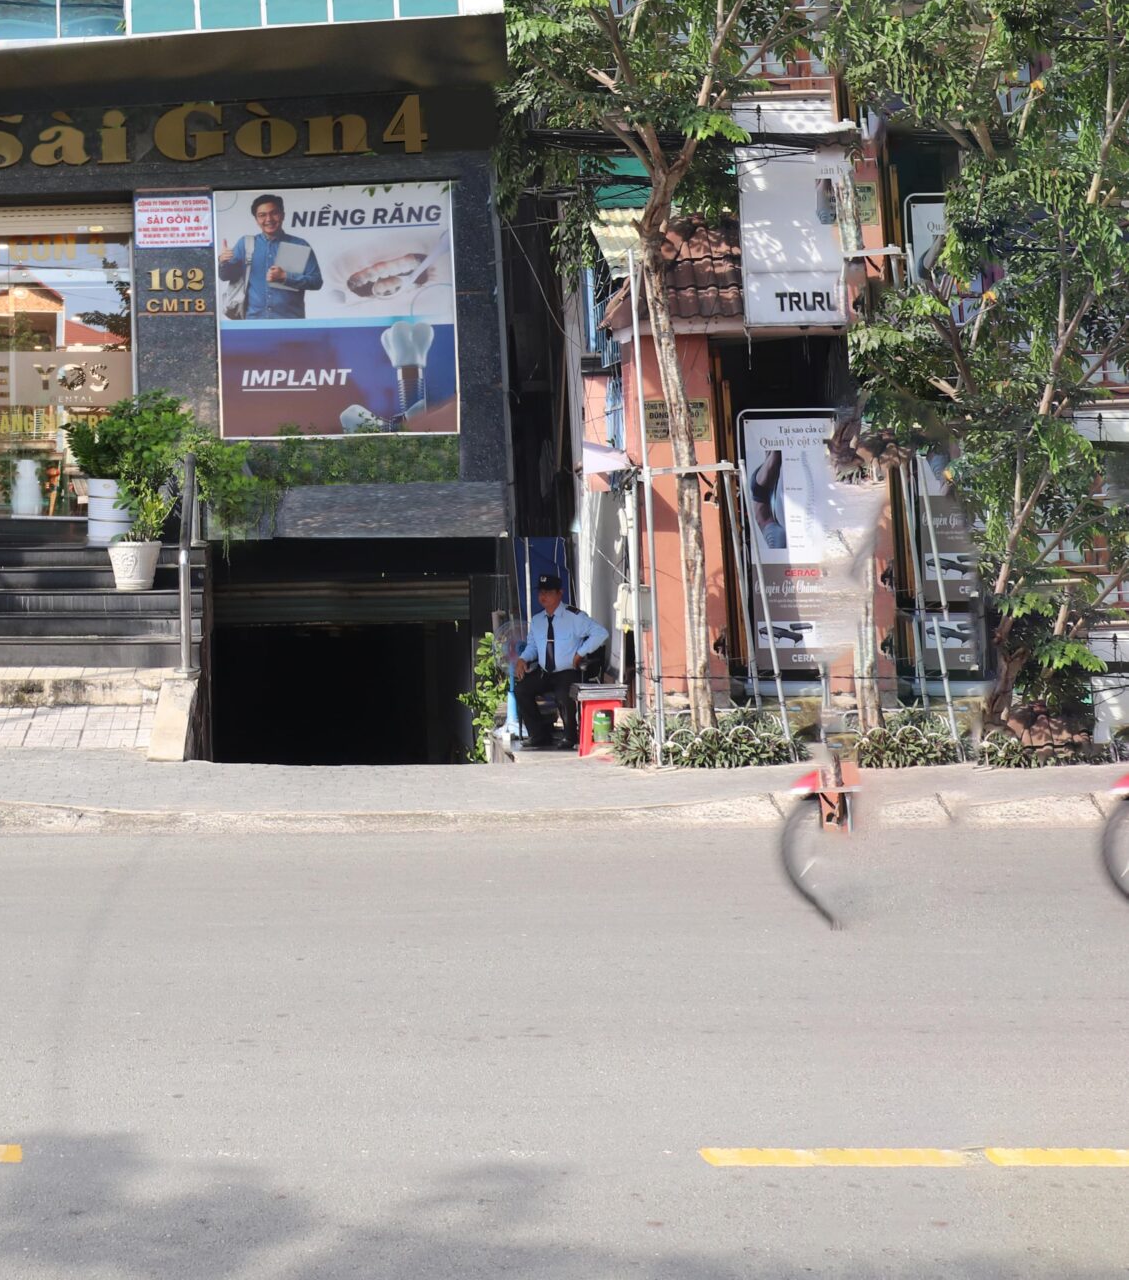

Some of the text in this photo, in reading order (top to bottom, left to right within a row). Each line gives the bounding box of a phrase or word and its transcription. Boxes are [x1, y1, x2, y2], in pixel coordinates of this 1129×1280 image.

[153, 100, 372, 163] Gòn
[382, 93, 429, 154] 4
[147, 213, 200, 224] SÀI GÒN 4
[290, 201, 442, 229] NIỀNG RĂNG
[147, 267, 204, 291] 162
[146, 298, 206, 312] CMT8
[32, 362, 110, 392] YO'S
[241, 367, 352, 388] IMPLANT
